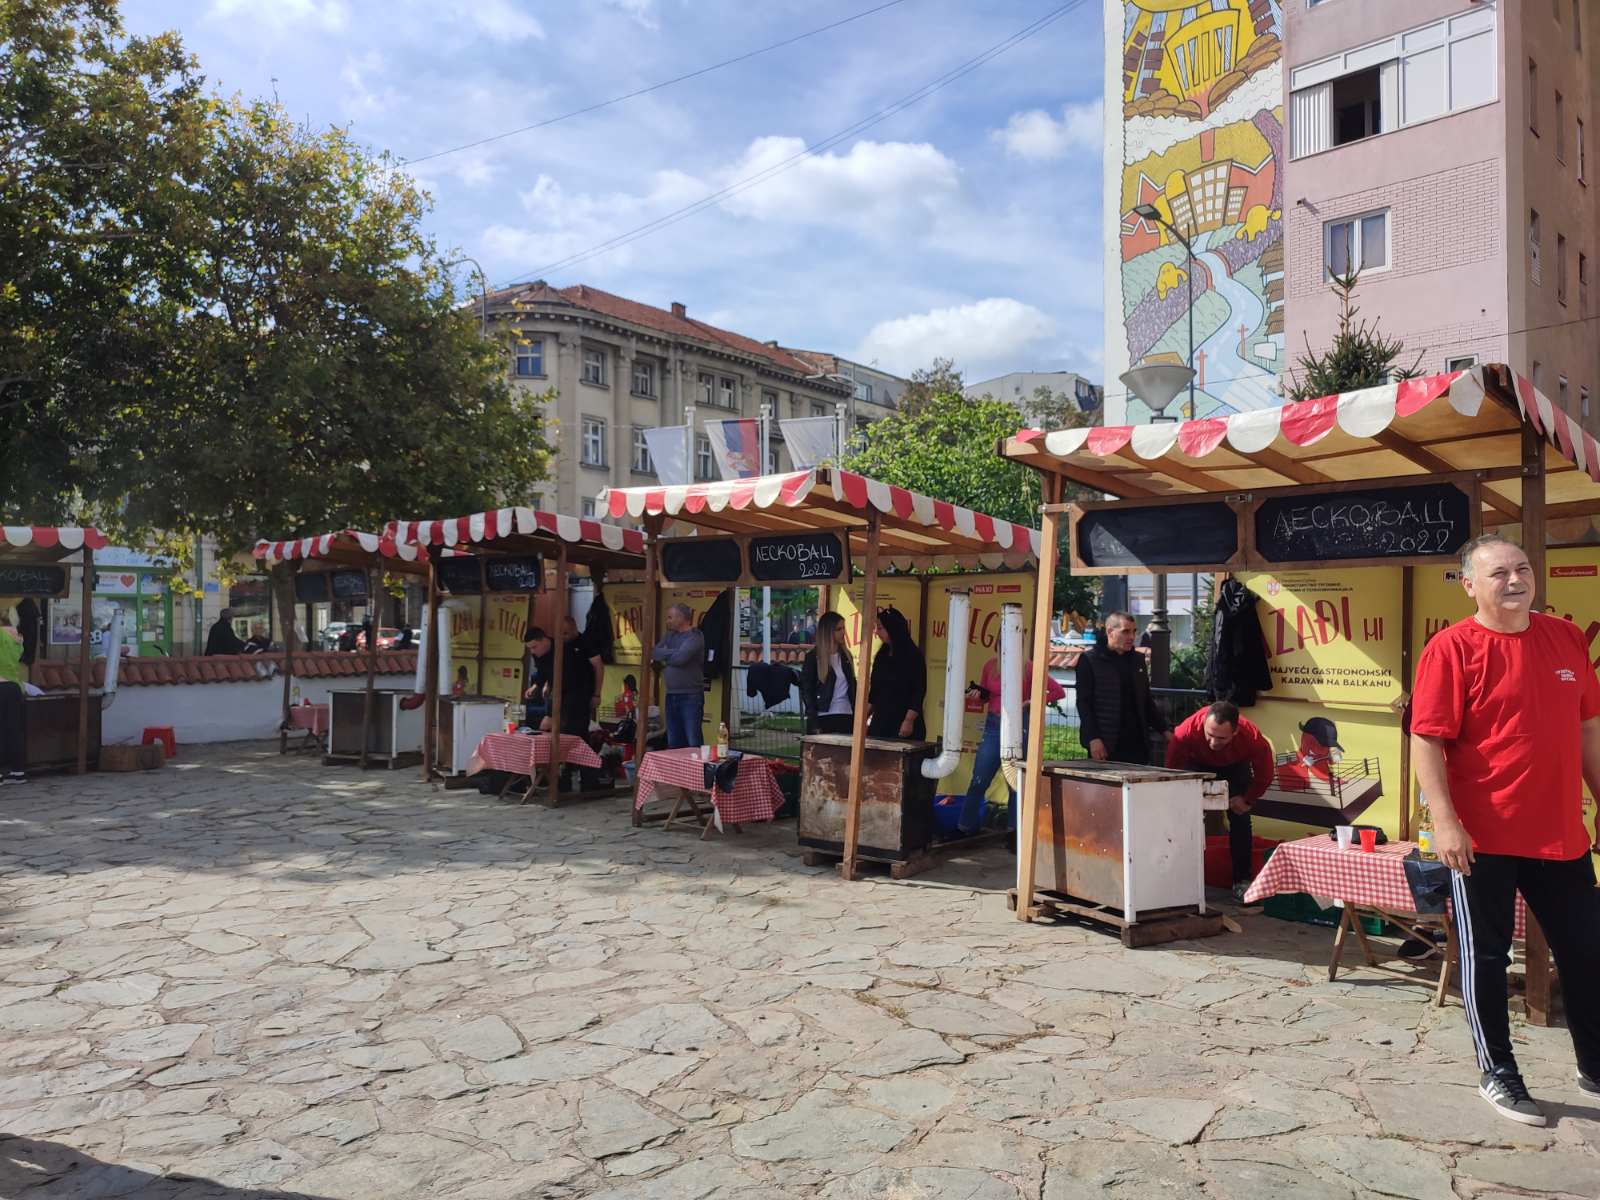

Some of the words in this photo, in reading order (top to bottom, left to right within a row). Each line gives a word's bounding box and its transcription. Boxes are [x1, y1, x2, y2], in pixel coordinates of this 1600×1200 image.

[1384, 528, 1450, 553] 2022
[756, 543, 835, 564] ЛЕСКОВАЦ
[799, 562, 831, 578] 2022
[1264, 596, 1352, 659] ZAĐI
[1270, 665, 1310, 675] NAJVEĆI
[1311, 667, 1392, 677] GASTRONOMSKI
[1281, 677, 1324, 685] KARAVAN
[1343, 679, 1391, 688] BALKANU
